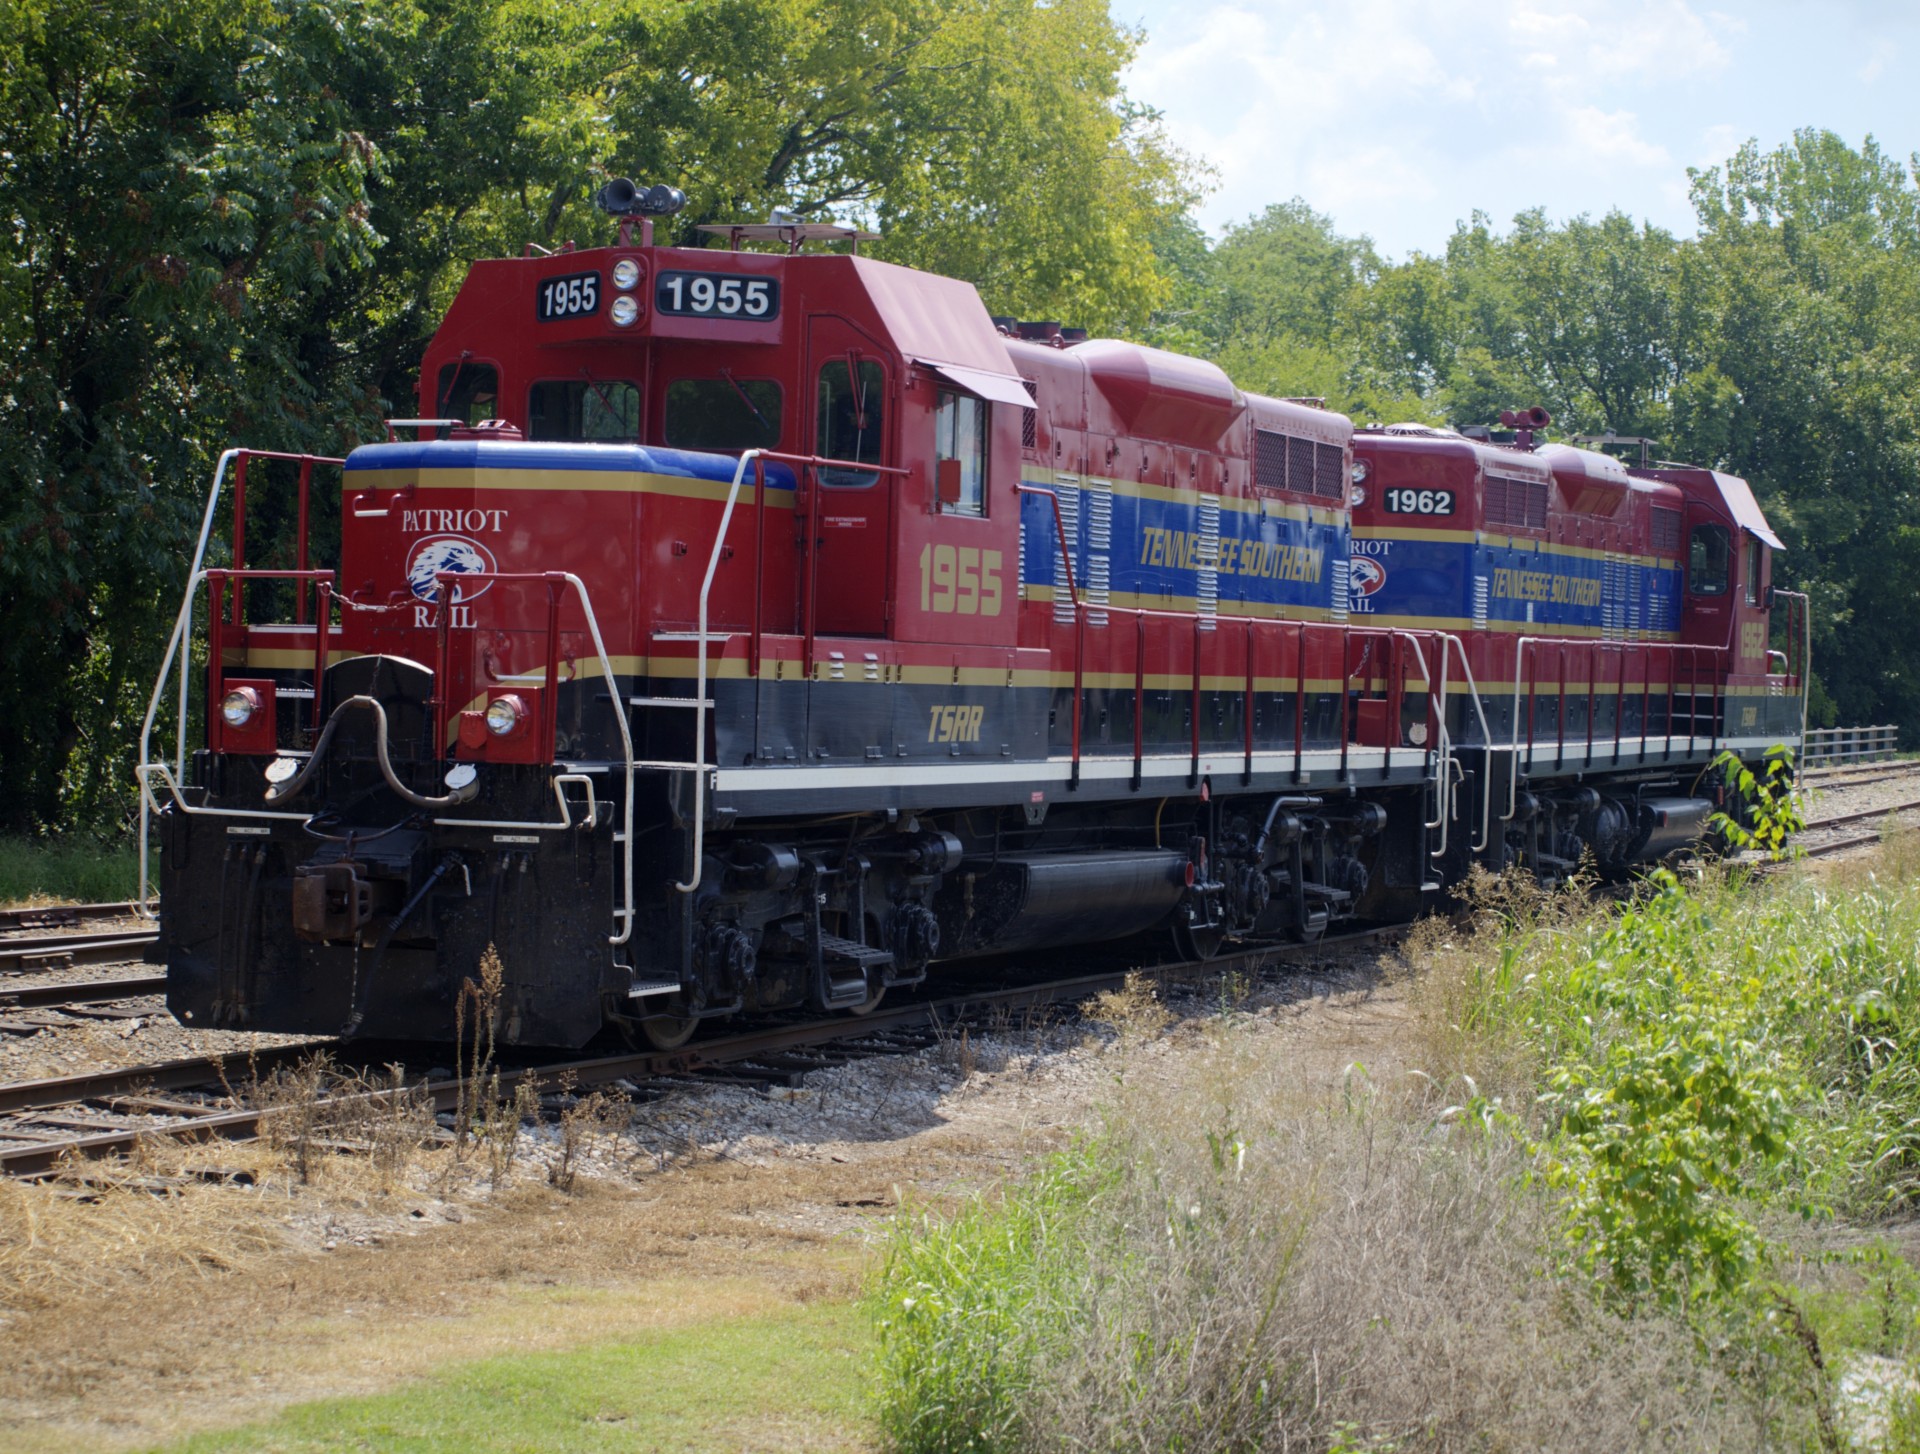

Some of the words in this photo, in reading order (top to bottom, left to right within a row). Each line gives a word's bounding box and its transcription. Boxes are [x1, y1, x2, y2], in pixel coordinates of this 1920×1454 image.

[544, 276, 596, 317] 1955
[666, 276, 770, 316] 1955
[401, 508, 509, 532] PATRIOT
[1387, 489, 1451, 514] 1962
[1140, 526, 1241, 574] TENNEEE
[1237, 539, 1326, 584] SOUTHERN
[1350, 541, 1393, 555] RIOT
[919, 542, 1003, 617] 1955
[1491, 567, 1553, 602] TENNESSEE
[1549, 574, 1601, 607] SOUTHERN
[1350, 598, 1375, 612] AIL
[1741, 622, 1765, 659] 1962
[927, 705, 985, 743] TSRR
[710, 772, 717, 790] F
